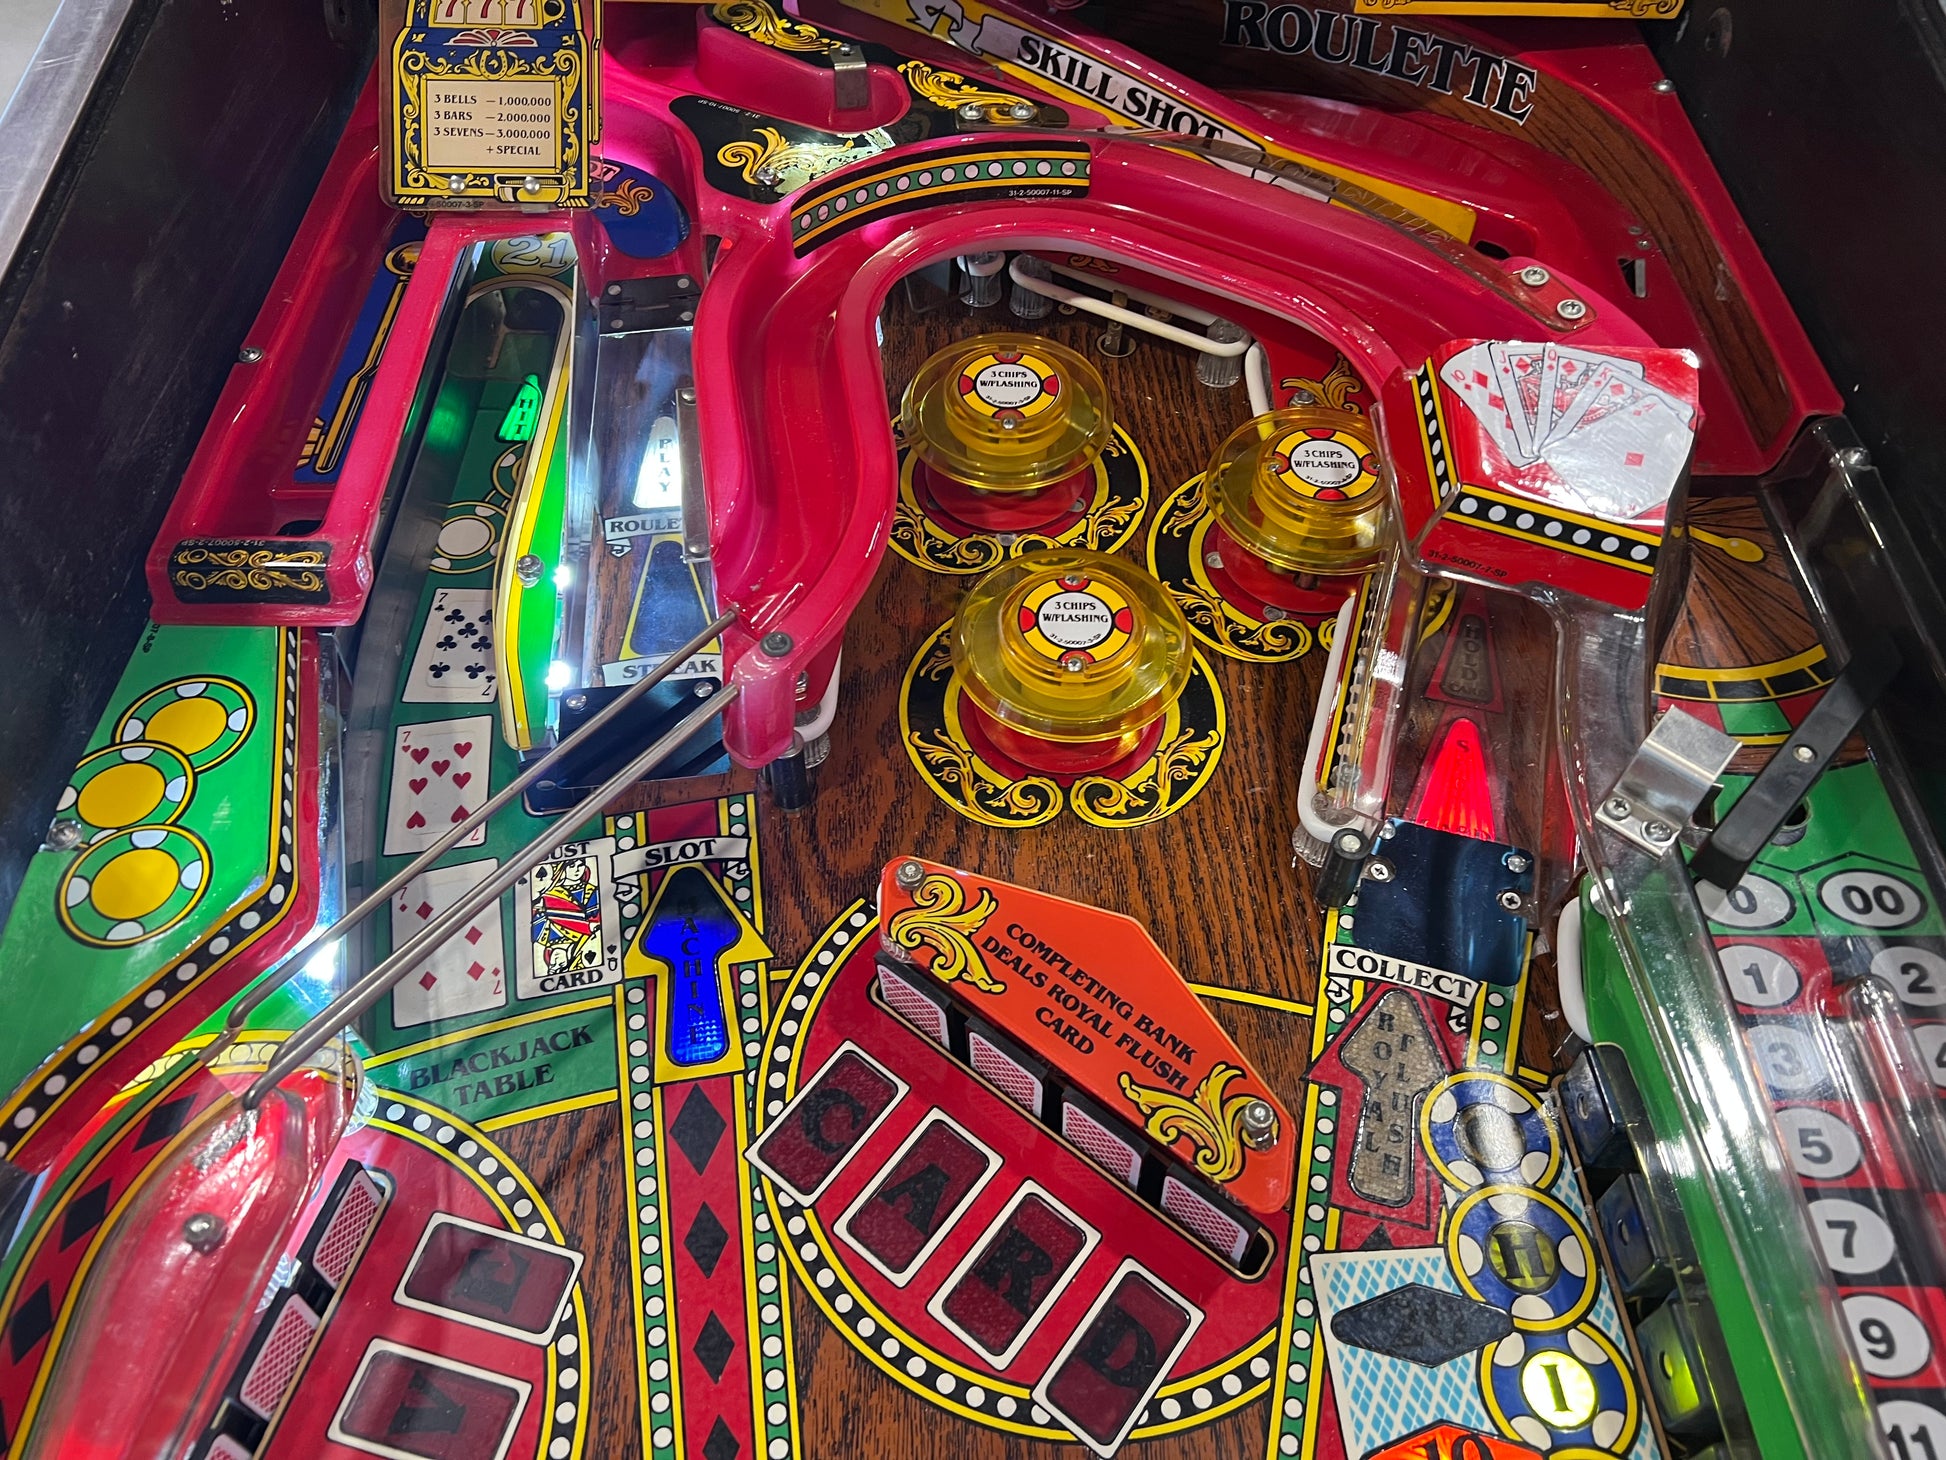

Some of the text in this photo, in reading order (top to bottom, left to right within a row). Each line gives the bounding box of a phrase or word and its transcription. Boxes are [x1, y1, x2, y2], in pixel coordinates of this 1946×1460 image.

[1220, 0, 1537, 126] ROULETTE
[434, 94, 441, 103] 3
[444, 94, 477, 104] BELLS
[1016, 35, 1223, 149] SKILL SHOT
[434, 111, 440, 119] 3
[444, 111, 472, 120] BARS
[434, 127, 440, 136] 3
[443, 127, 484, 137] SEVENS
[496, 145, 541, 155] SPECIAL
[500, 236, 568, 268] 21
[979, 380, 1038, 388] W/FLASHING
[515, 398, 535, 434] HIT
[658, 438, 673, 493] PLAY
[1294, 460, 1355, 469] W/FLASHING
[1312, 450, 1343, 458] CHIPS
[610, 518, 682, 533] ROULE
[438, 592, 448, 603] 7
[1055, 602, 1096, 610] 3 CHIPS
[1042, 613, 1109, 623] W/FLASHING
[622, 659, 717, 679] STAK
[403, 731, 411, 742] 7
[542, 842, 590, 861] UST
[645, 838, 718, 866] SLOT
[1726, 884, 1905, 915] 0 00
[539, 968, 604, 992] CARD
[1336, 949, 1473, 1000] COLLECT
[1743, 962, 1936, 994] 1 2
[1006, 923, 1197, 1065] COMPLETING BANK
[981, 936, 1190, 1091] DEALS ROYAL FLUSH
[1035, 1006, 1095, 1055] CARD
[410, 1024, 595, 1091] BLACKJACK
[1768, 1041, 1803, 1077] 3
[453, 1063, 556, 1107] TABLE
[1366, 1011, 1395, 1153] ROYAL
[1382, 1034, 1417, 1177] FLUSH
[1798, 1128, 1834, 1165] 5
[1826, 1220, 1858, 1258] 7
[1859, 1317, 1897, 1360] 9
[1887, 1424, 1940, 1460] 11
